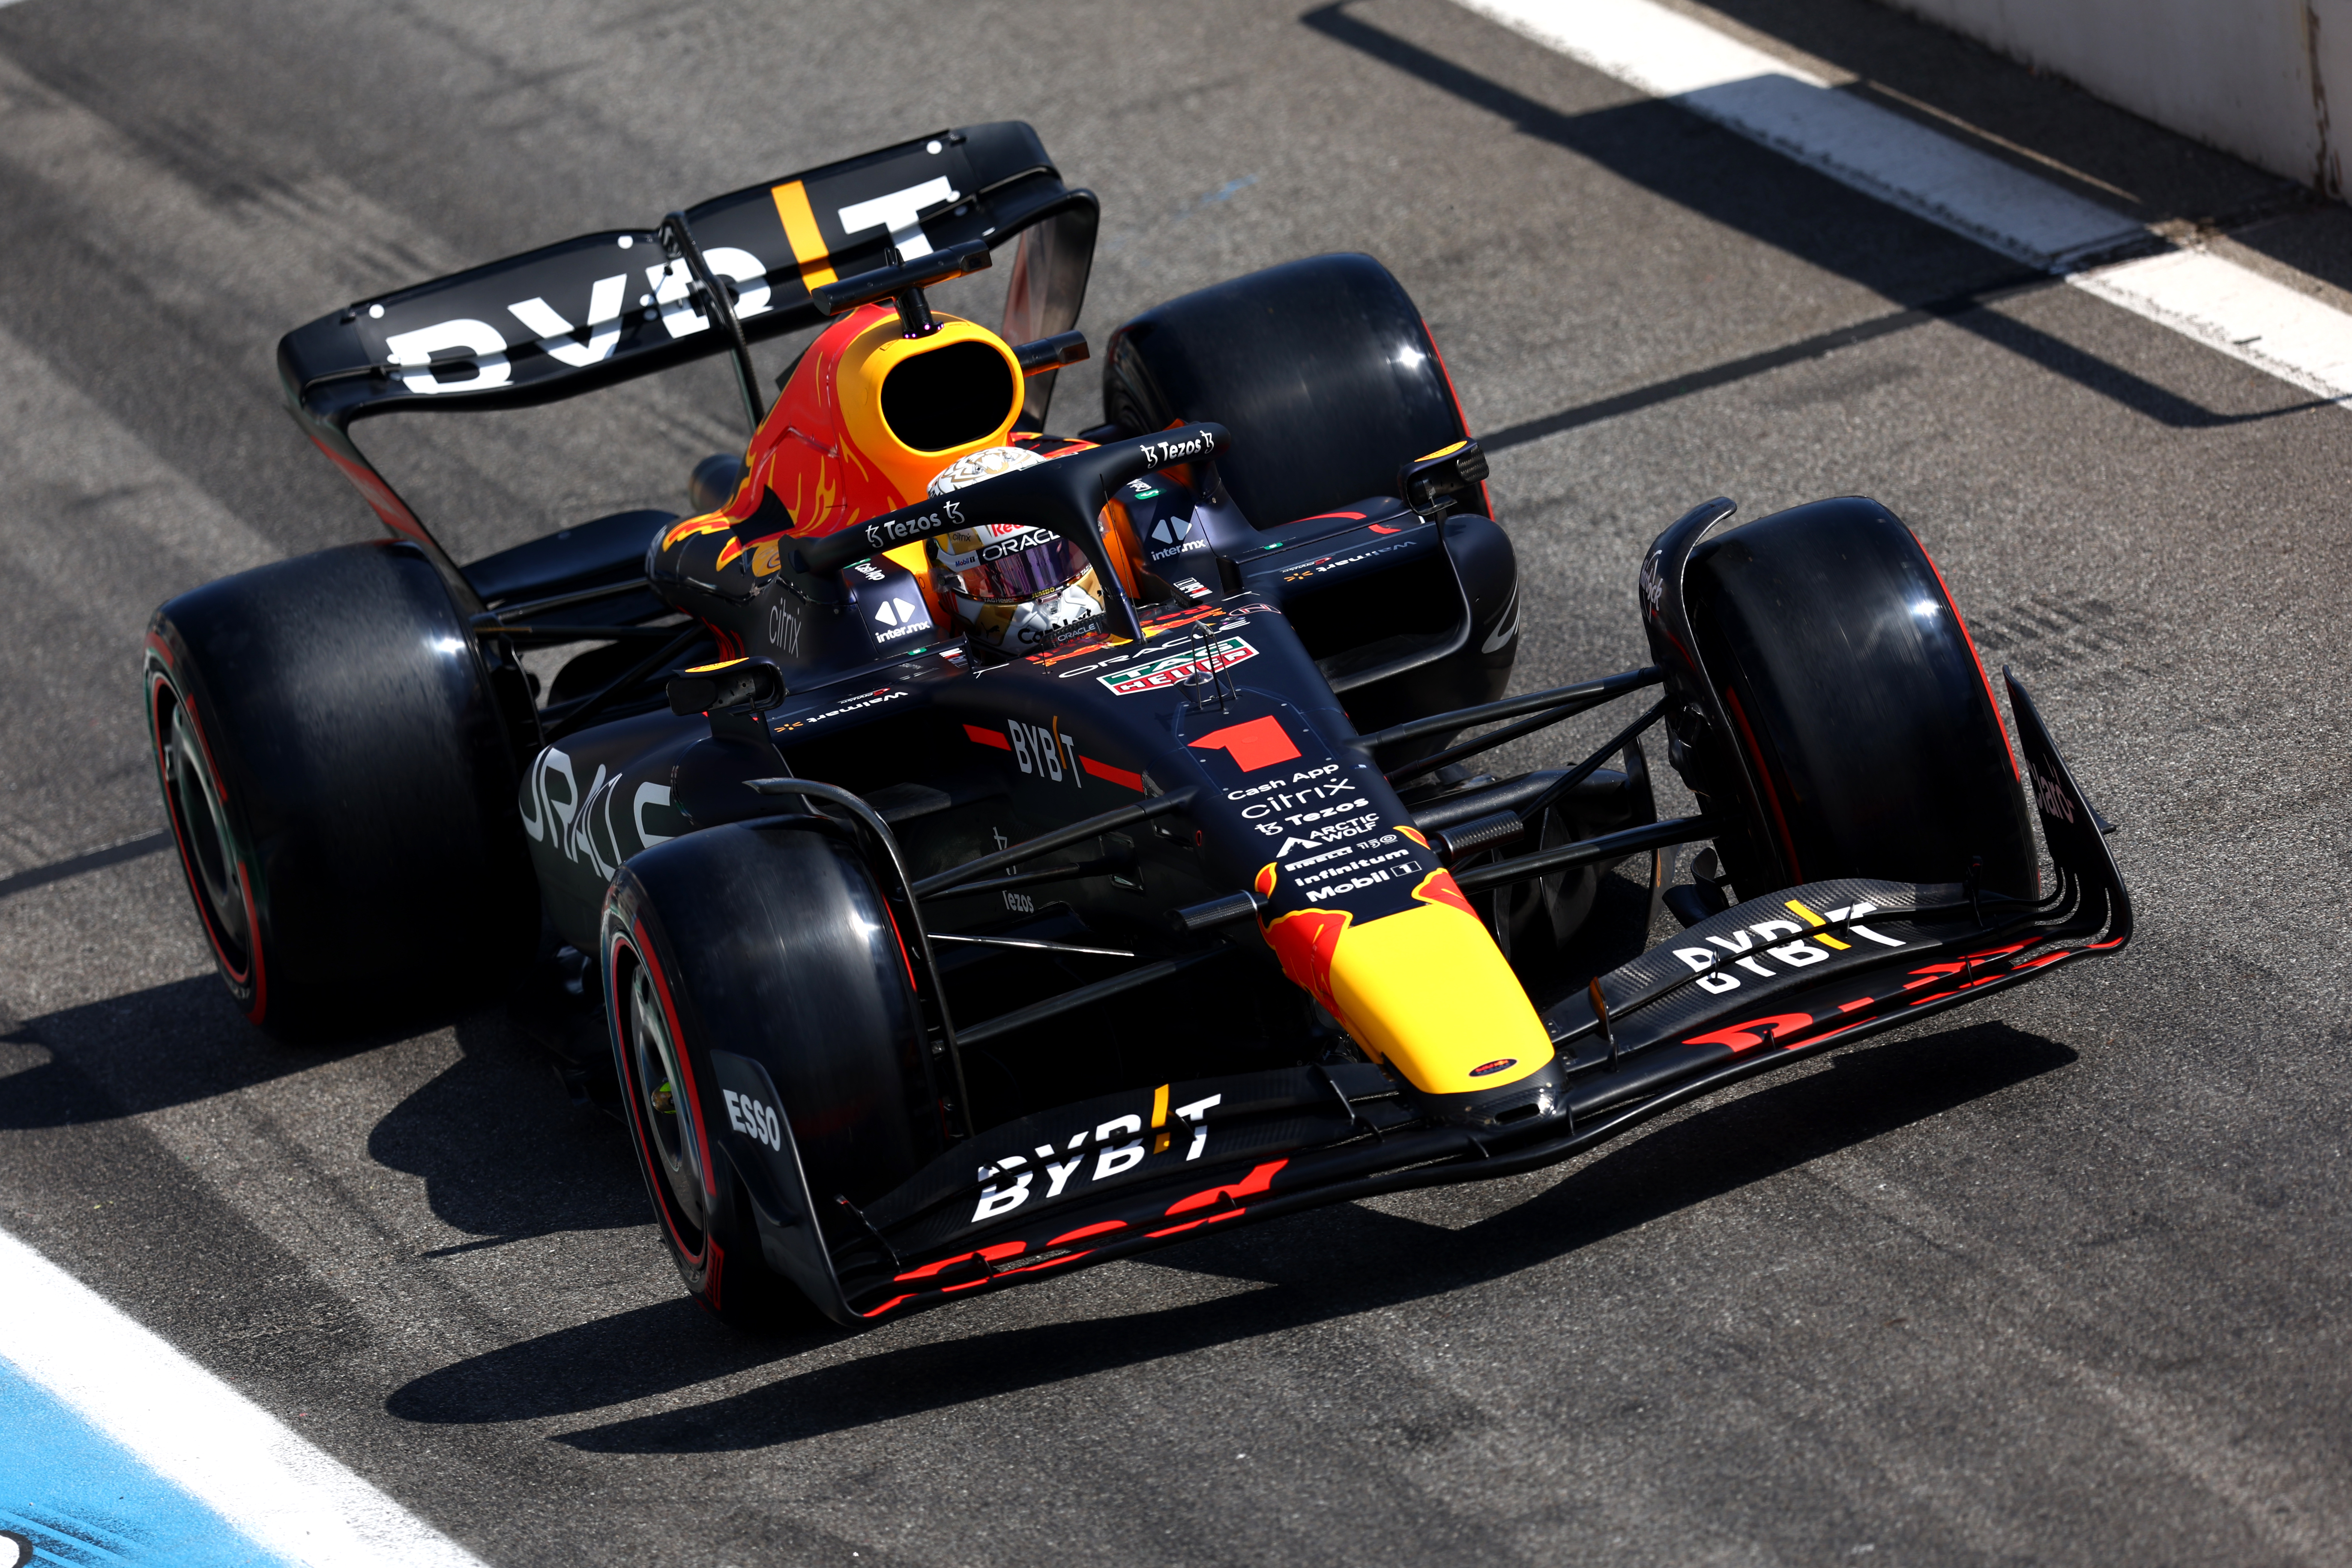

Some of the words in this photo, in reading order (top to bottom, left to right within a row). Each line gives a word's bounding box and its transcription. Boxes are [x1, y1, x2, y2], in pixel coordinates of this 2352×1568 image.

[1157, 439, 1201, 461] Tezos
[884, 513, 942, 541] Tezos
[953, 533, 971, 542] citrix
[983, 528, 1060, 561] ORACL
[1151, 539, 1206, 561] inter.mx
[1315, 541, 1417, 572] Walmart
[955, 558, 970, 567] Mobil
[769, 597, 802, 658] citrix
[875, 620, 931, 643] inter.mx
[1057, 623, 1096, 642] ORACLE
[1059, 620, 1251, 678] ORACLE
[1112, 641, 1234, 678] TAG
[806, 691, 909, 723] Walmart
[1007, 715, 1082, 788] BYBIT
[1188, 715, 1302, 772] 1
[1227, 779, 1286, 800] Cash
[1293, 764, 1339, 783] App
[1242, 778, 1356, 818] citrix
[2026, 753, 2075, 824] Claro
[1285, 798, 1369, 826] Tezos
[1310, 813, 1379, 839] ARCTIC
[1322, 821, 1376, 842] WOLF
[1285, 846, 1353, 871] PIRELLI
[1295, 849, 1409, 886] infinitum
[1306, 870, 1390, 902] Mobil
[722, 1089, 781, 1152] ESSO
[971, 1083, 1221, 1223] BYBIT
